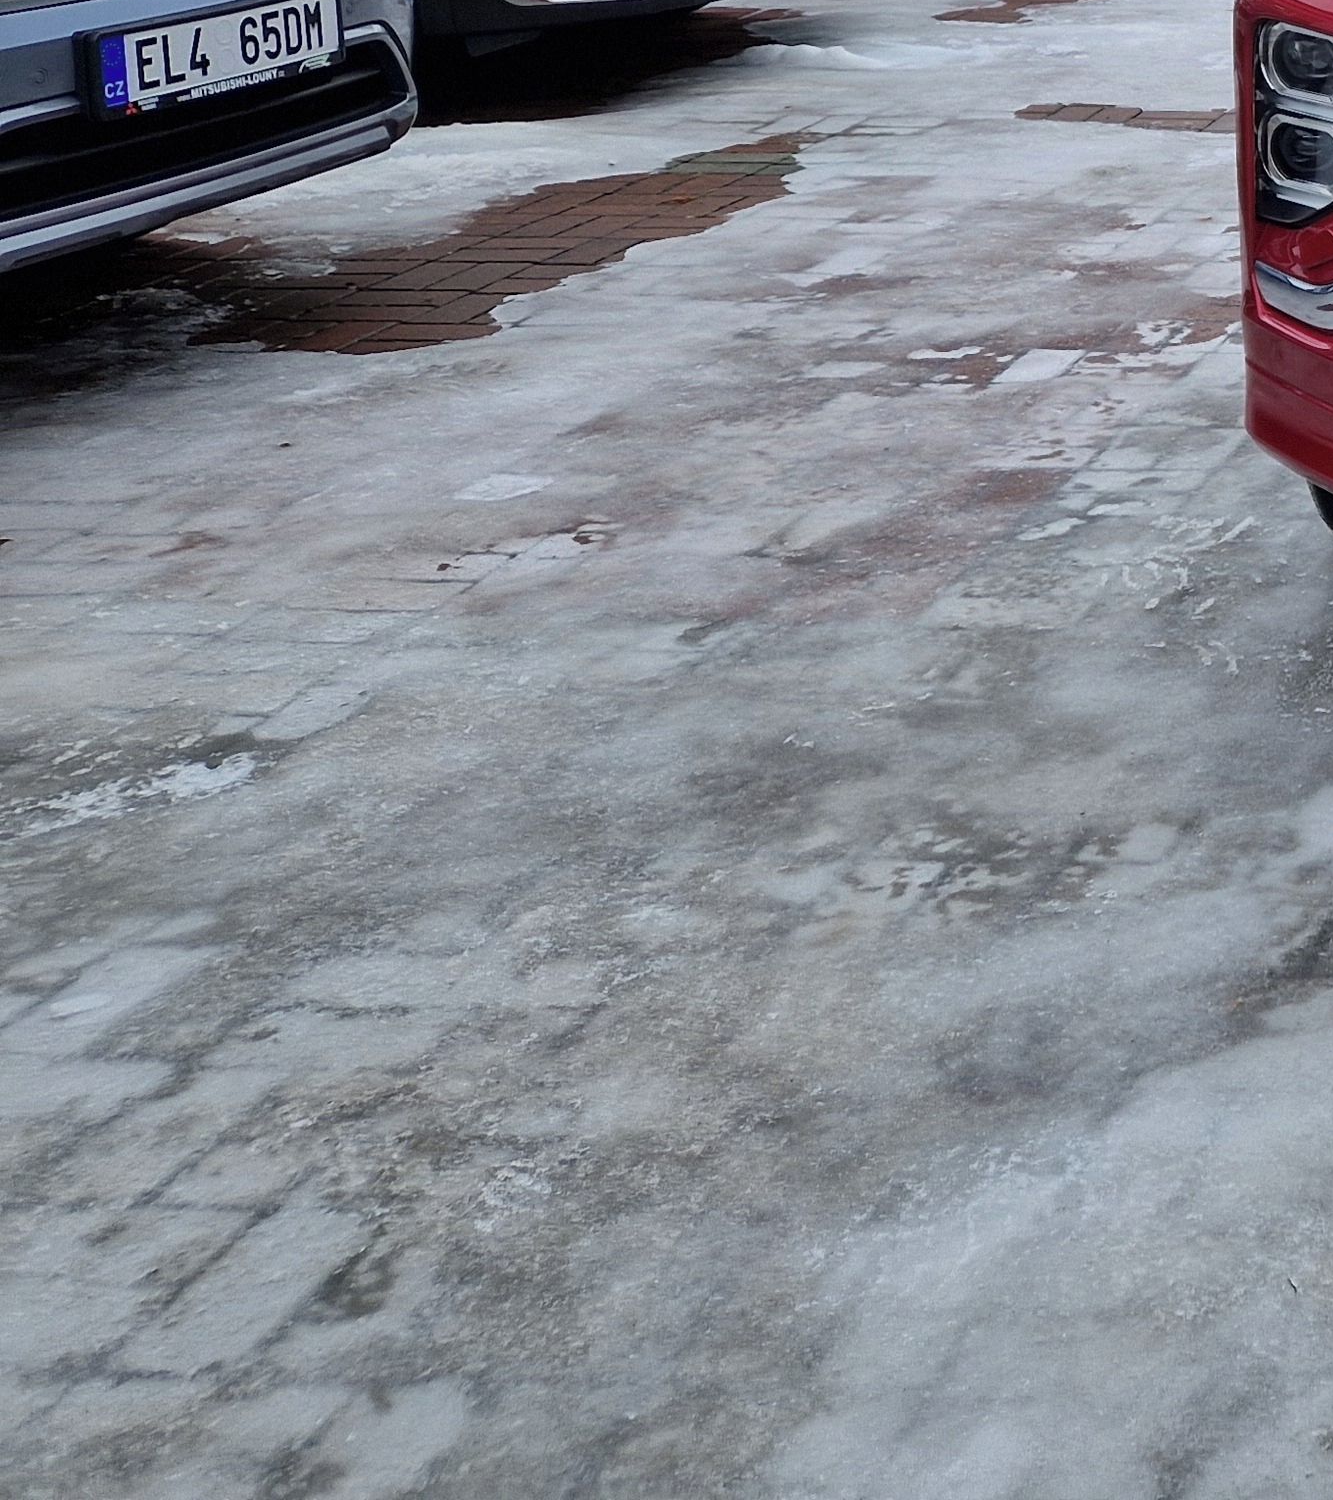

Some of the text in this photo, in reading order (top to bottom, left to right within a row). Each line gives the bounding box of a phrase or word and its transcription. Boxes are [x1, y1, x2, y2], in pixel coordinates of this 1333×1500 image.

[135, 1, 324, 91] EL4 65DM
[104, 80, 126, 99] CZ
